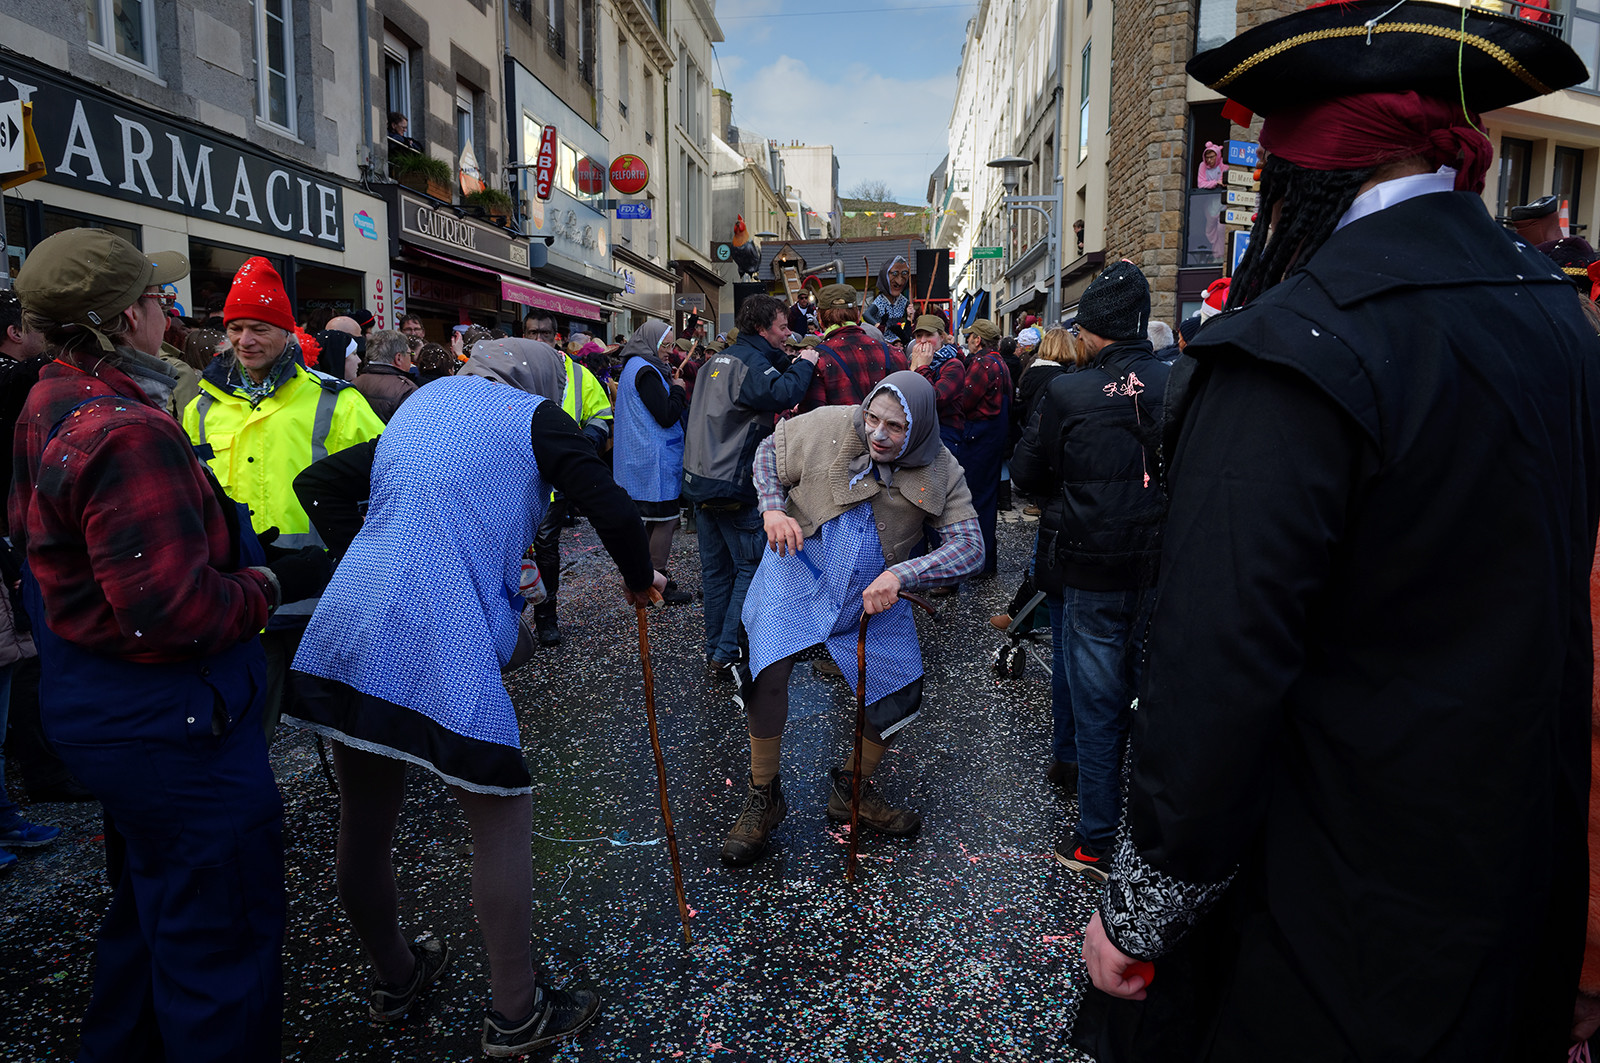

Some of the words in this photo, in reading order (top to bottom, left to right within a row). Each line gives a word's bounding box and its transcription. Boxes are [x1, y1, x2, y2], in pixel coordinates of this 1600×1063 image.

[537, 128, 554, 195] TABAC
[611, 170, 645, 180] PELFORTH
[417, 207, 476, 250] GAUFRERIE
